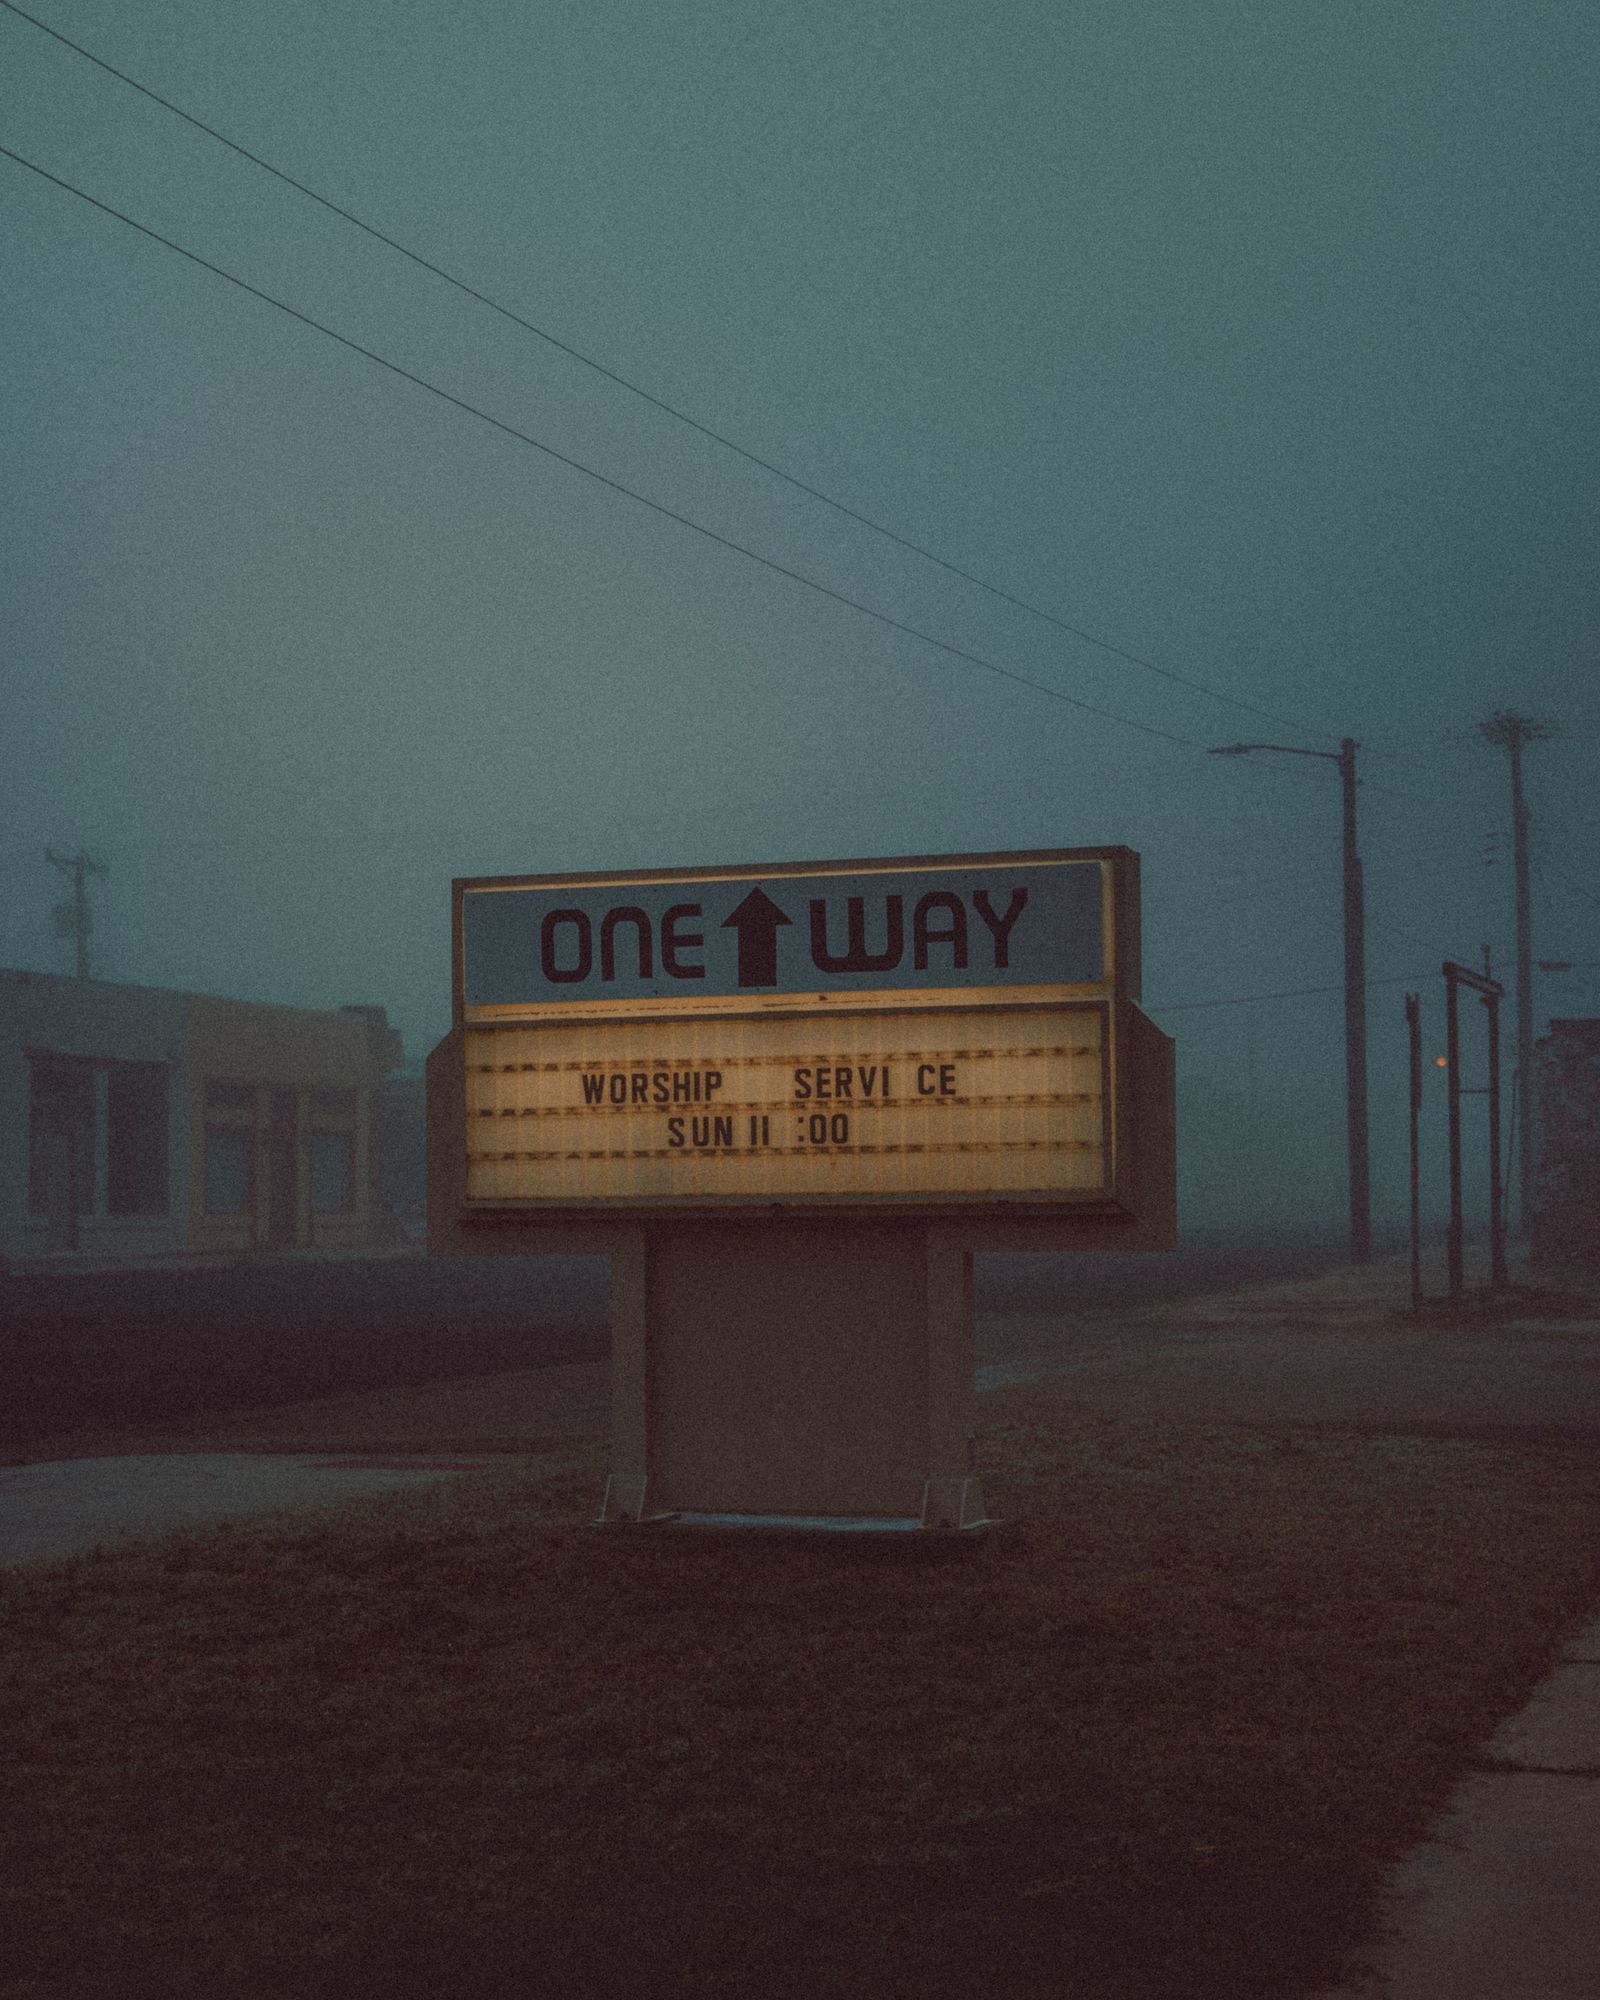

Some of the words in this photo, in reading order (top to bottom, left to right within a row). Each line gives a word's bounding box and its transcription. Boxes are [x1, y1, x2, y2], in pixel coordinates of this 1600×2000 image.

[541, 903, 705, 984] ONE
[810, 888, 1029, 974] WAY
[581, 1071, 723, 1105] WORSHIP
[668, 1115, 733, 1148] SUN
